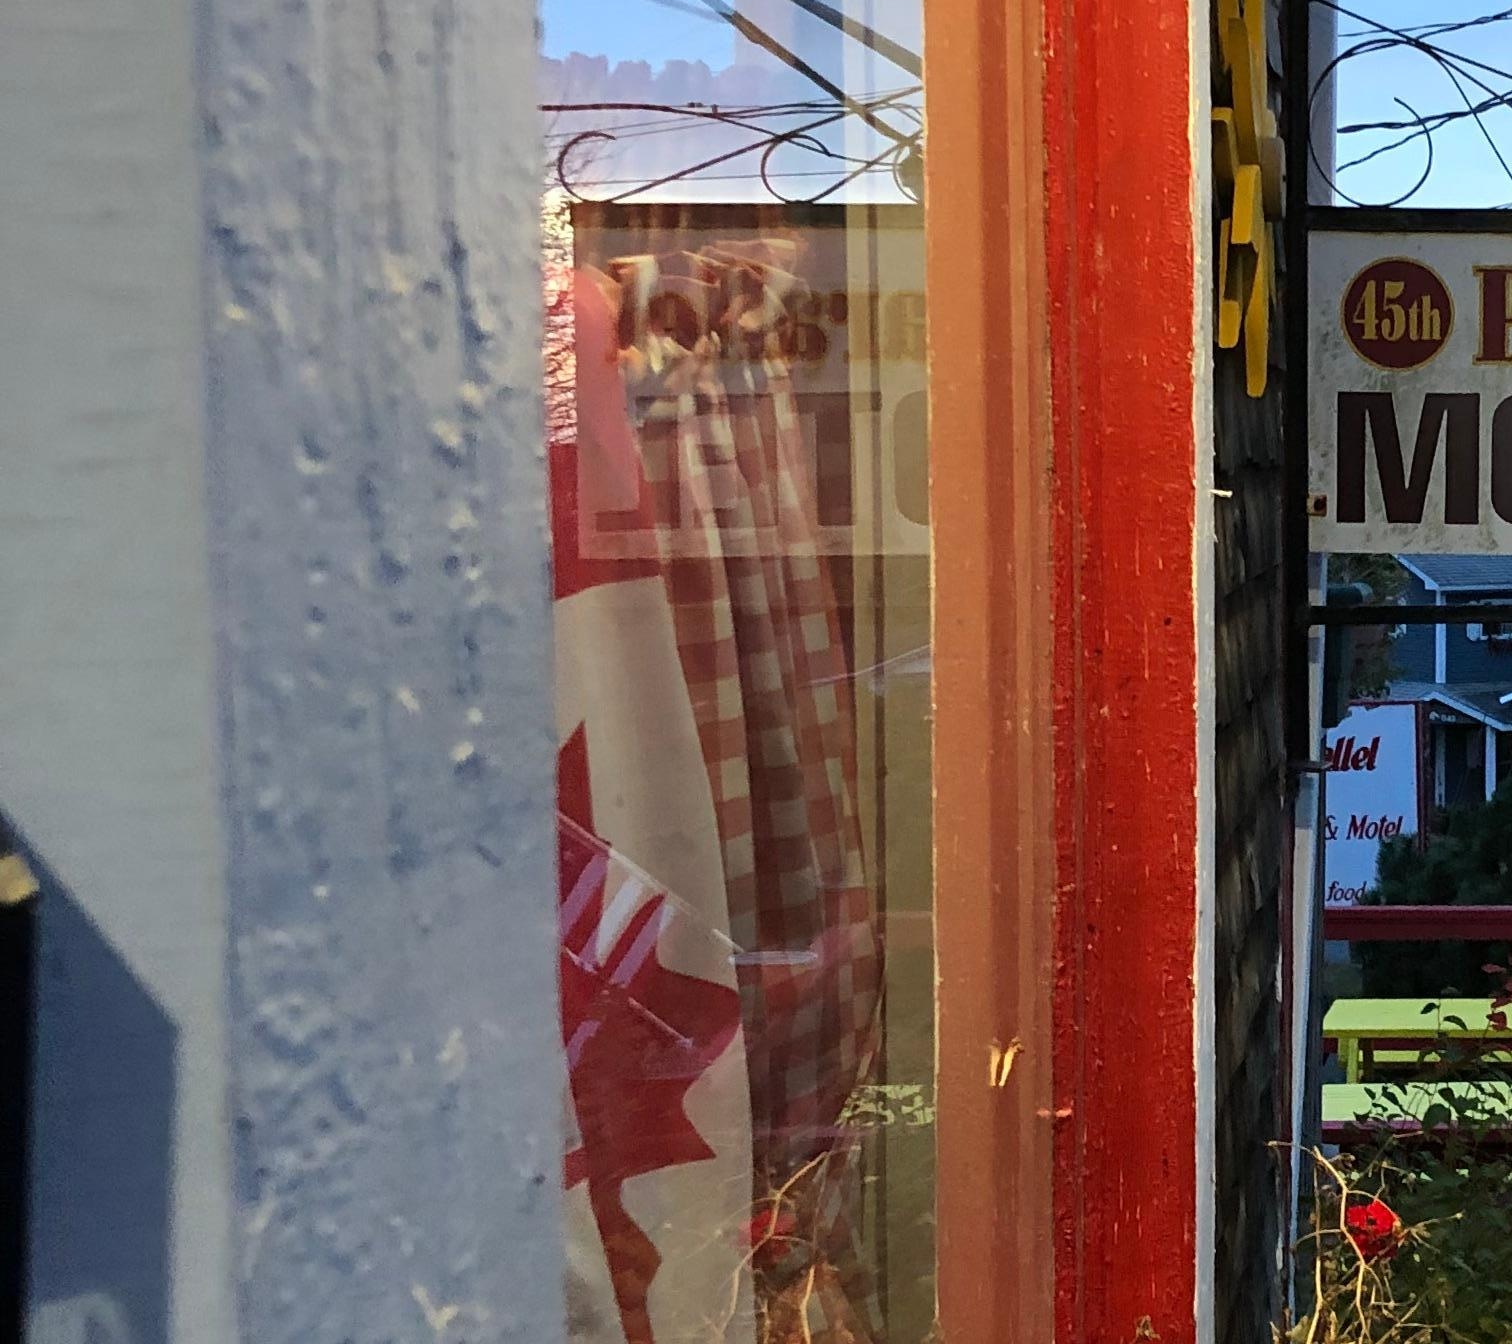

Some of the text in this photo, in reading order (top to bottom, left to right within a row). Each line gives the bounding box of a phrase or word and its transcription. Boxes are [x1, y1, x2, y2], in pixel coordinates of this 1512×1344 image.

[1352, 280, 1442, 341] 45th
[1325, 814, 1404, 841] & Motel
[1326, 881, 1368, 902] food
